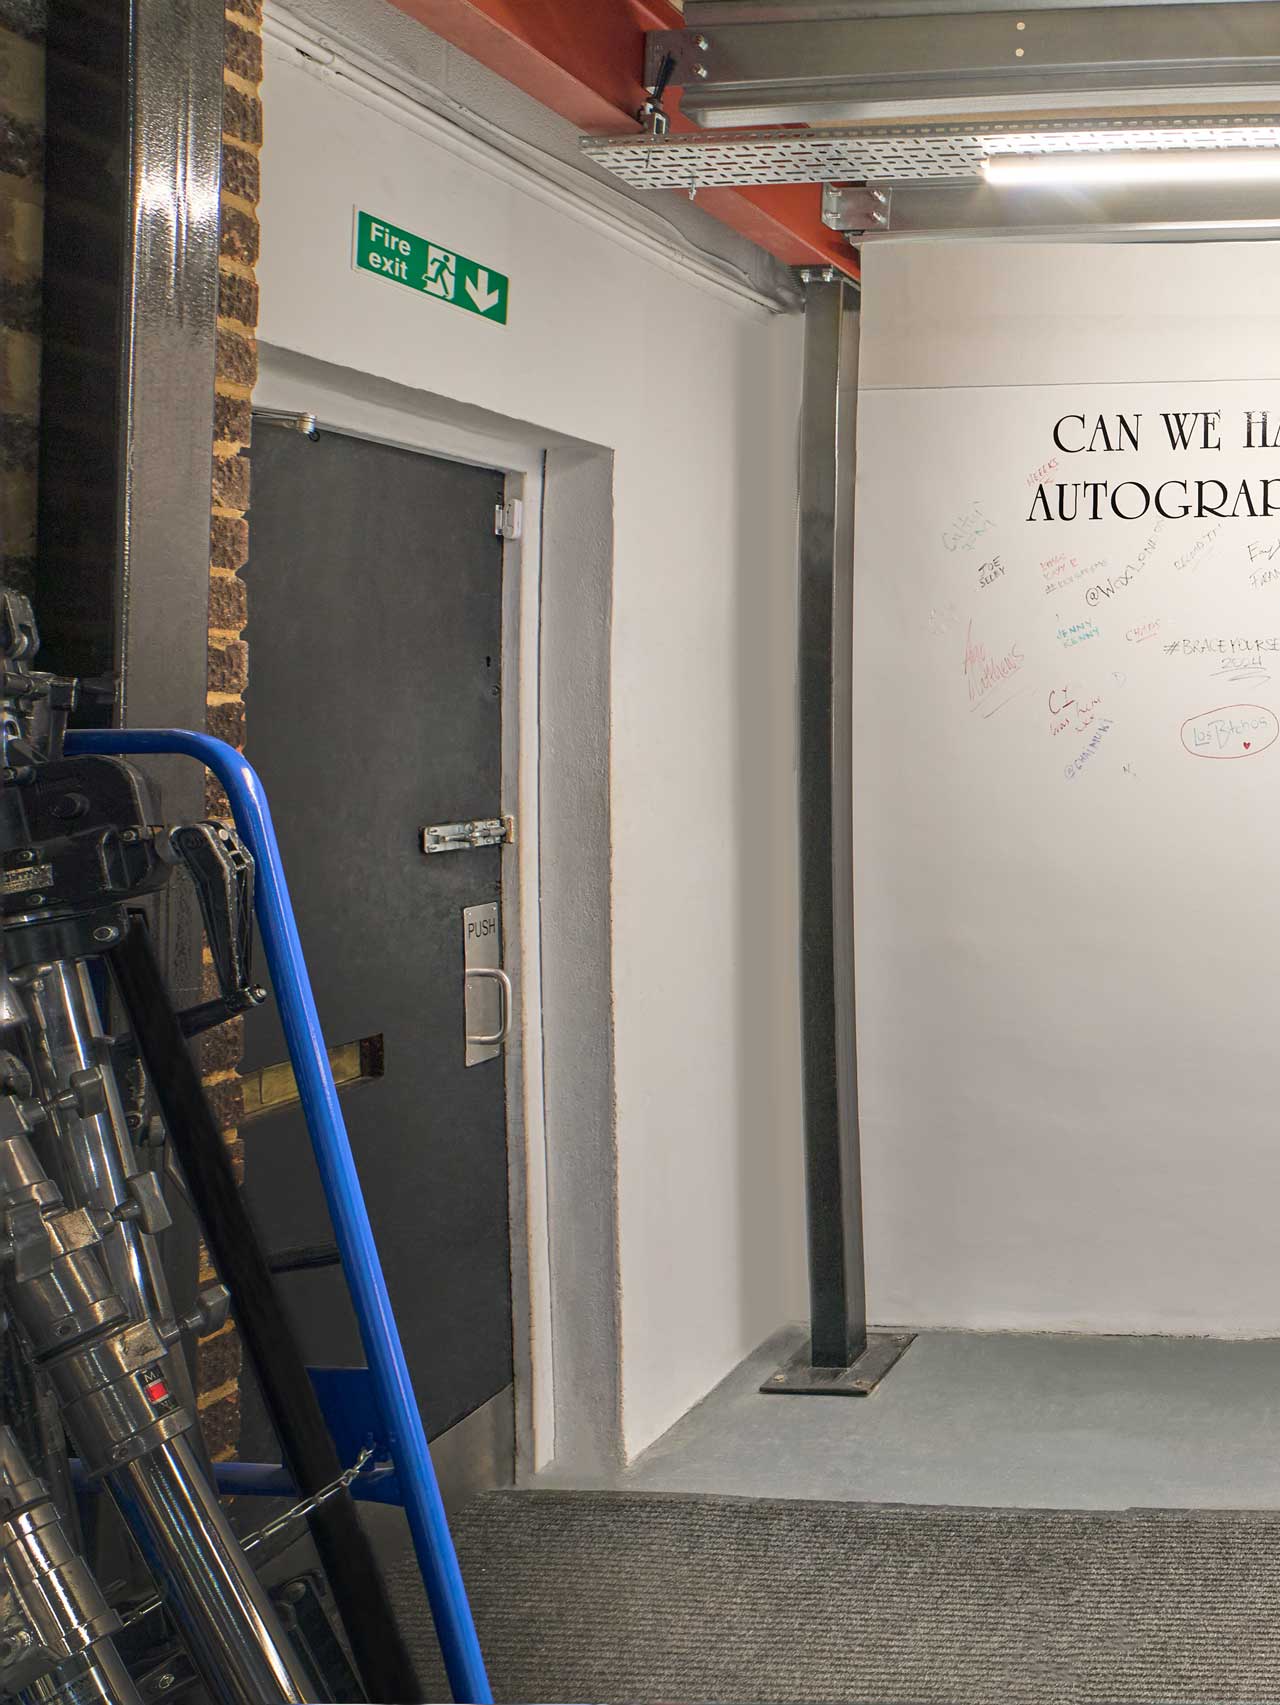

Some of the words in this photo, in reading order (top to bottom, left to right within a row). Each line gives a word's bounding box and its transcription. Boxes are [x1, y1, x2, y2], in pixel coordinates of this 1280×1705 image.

[370, 222, 412, 256] Fire
[368, 251, 408, 281] exit
[1052, 413, 1142, 453] CAN
[1160, 410, 1221, 451] WE
[468, 918, 496, 940] PUSH
